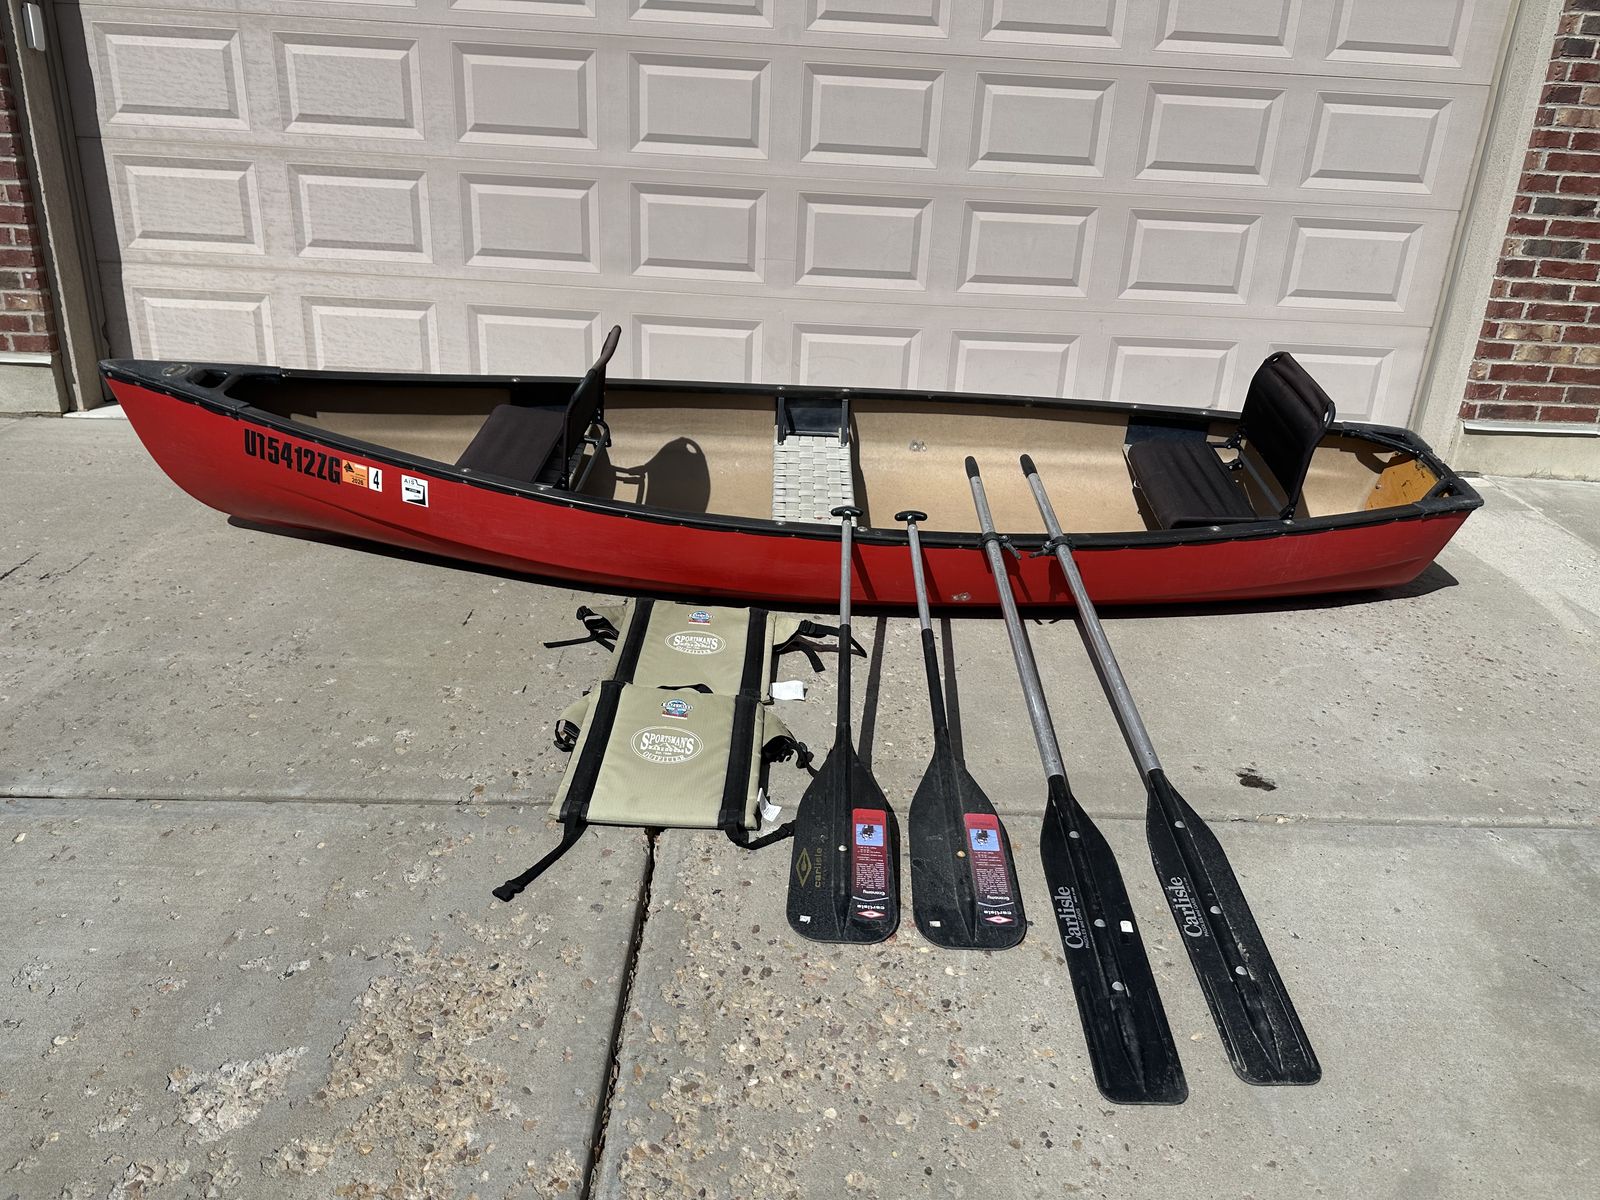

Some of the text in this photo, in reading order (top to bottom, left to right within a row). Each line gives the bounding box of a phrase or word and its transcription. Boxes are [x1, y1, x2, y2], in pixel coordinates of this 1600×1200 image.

[244, 428, 341, 485] UT5412ZG
[373, 470, 380, 489] 4
[640, 732, 695, 755] SPORTSMAN'S
[814, 847, 822, 888] carlisle
[1054, 886, 1084, 948] Carlisle
[1168, 876, 1203, 937] Carlisle
